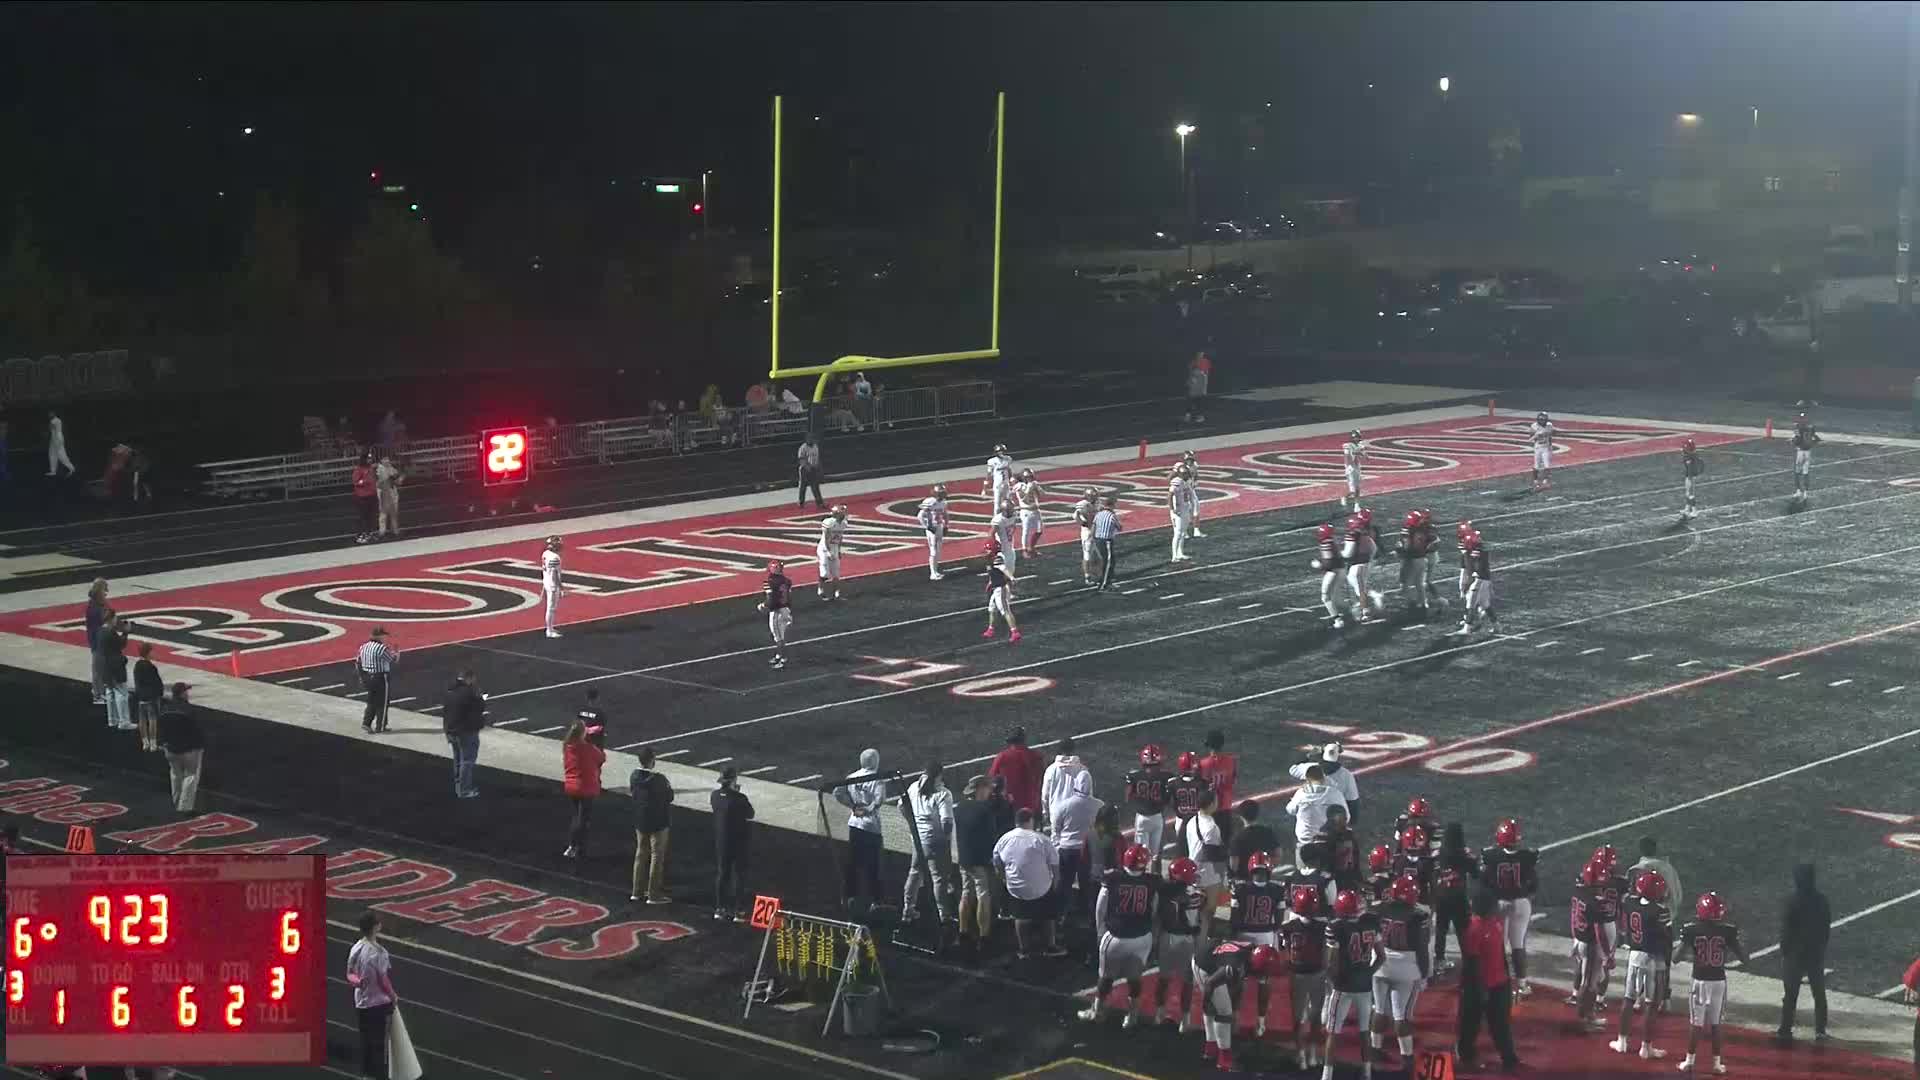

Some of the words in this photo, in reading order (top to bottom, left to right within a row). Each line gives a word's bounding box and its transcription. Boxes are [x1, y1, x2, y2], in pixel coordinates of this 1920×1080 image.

[489, 433, 523, 472] 22
[28, 420, 1697, 660] BOLINGBROOK
[245, 882, 304, 911] GUEST
[753, 899, 775, 925] 20
[15, 917, 32, 959] 6
[281, 911, 300, 954] 6
[9, 969, 24, 1002] 3
[271, 966, 285, 999] 3
[56, 989, 66, 1025] 1
[112, 986, 130, 1027] 6
[179, 985, 197, 1027] 6
[226, 984, 244, 1026] 2
